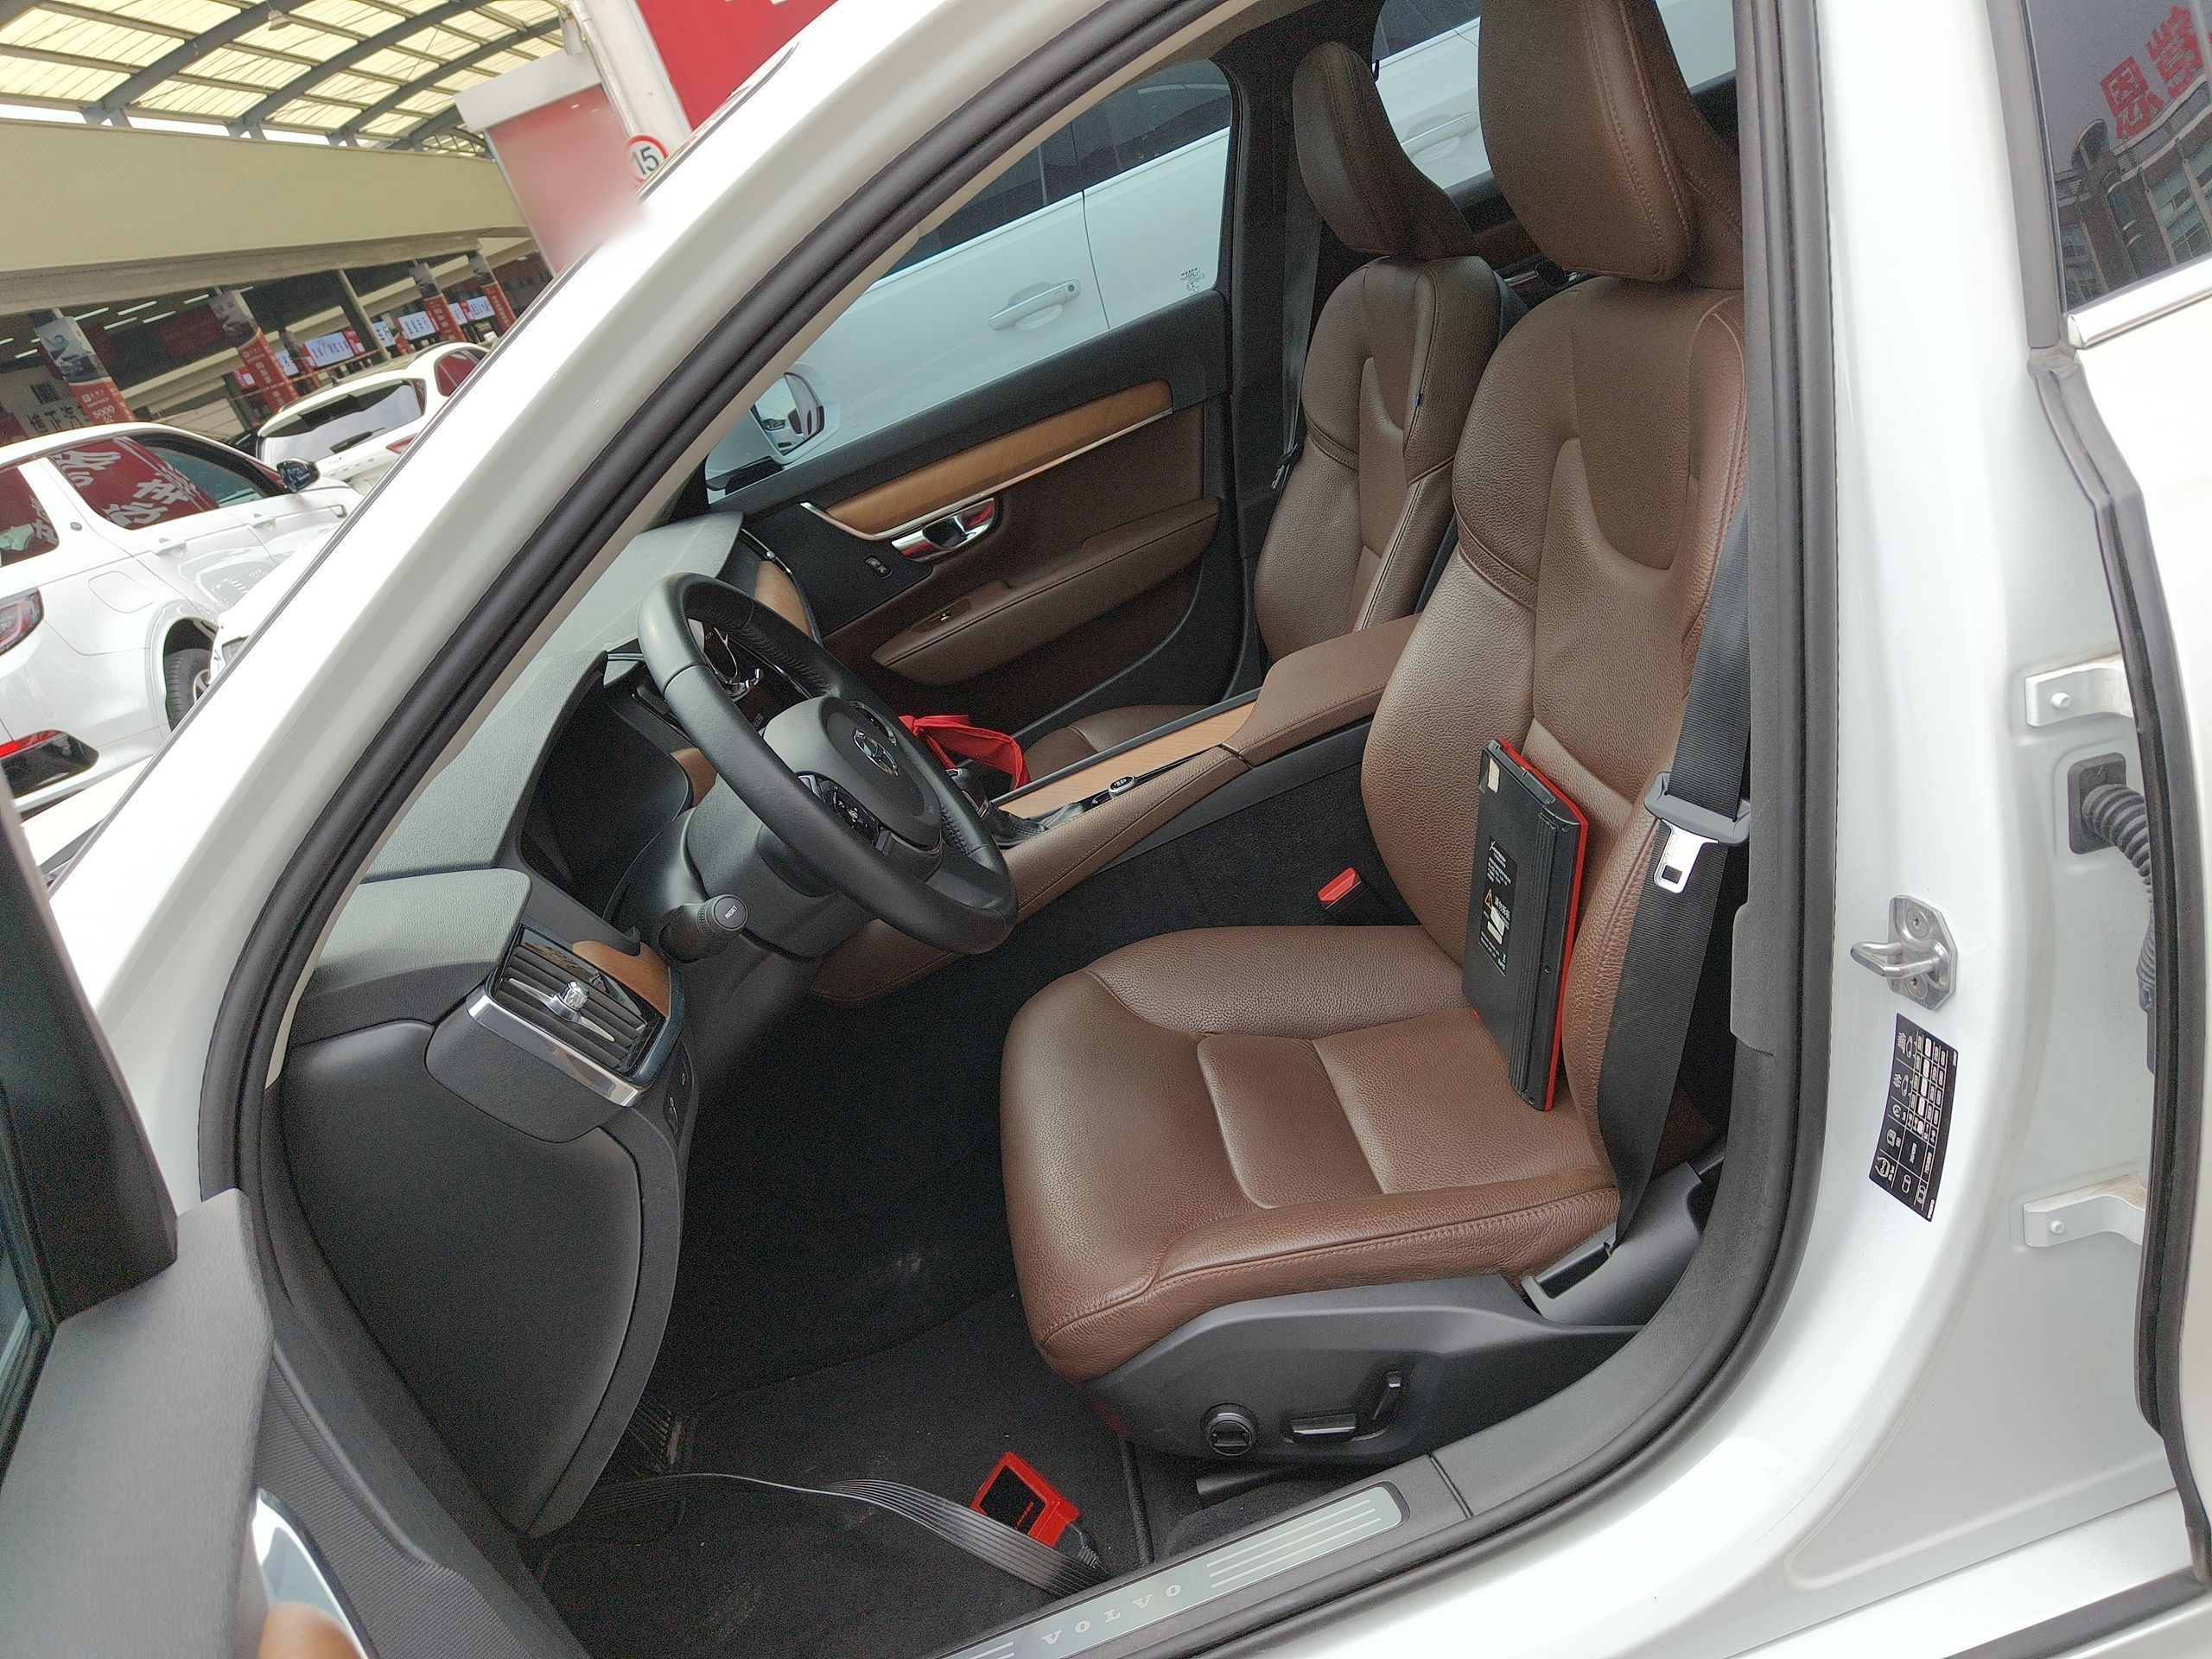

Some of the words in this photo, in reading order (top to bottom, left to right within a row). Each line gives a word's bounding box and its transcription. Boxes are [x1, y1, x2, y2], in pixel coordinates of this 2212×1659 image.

[631, 145, 659, 175] 15
[93, 405, 115, 419] 5000
[724, 905, 738, 919] RESET
[1041, 1584, 1181, 1645] VOLVO
